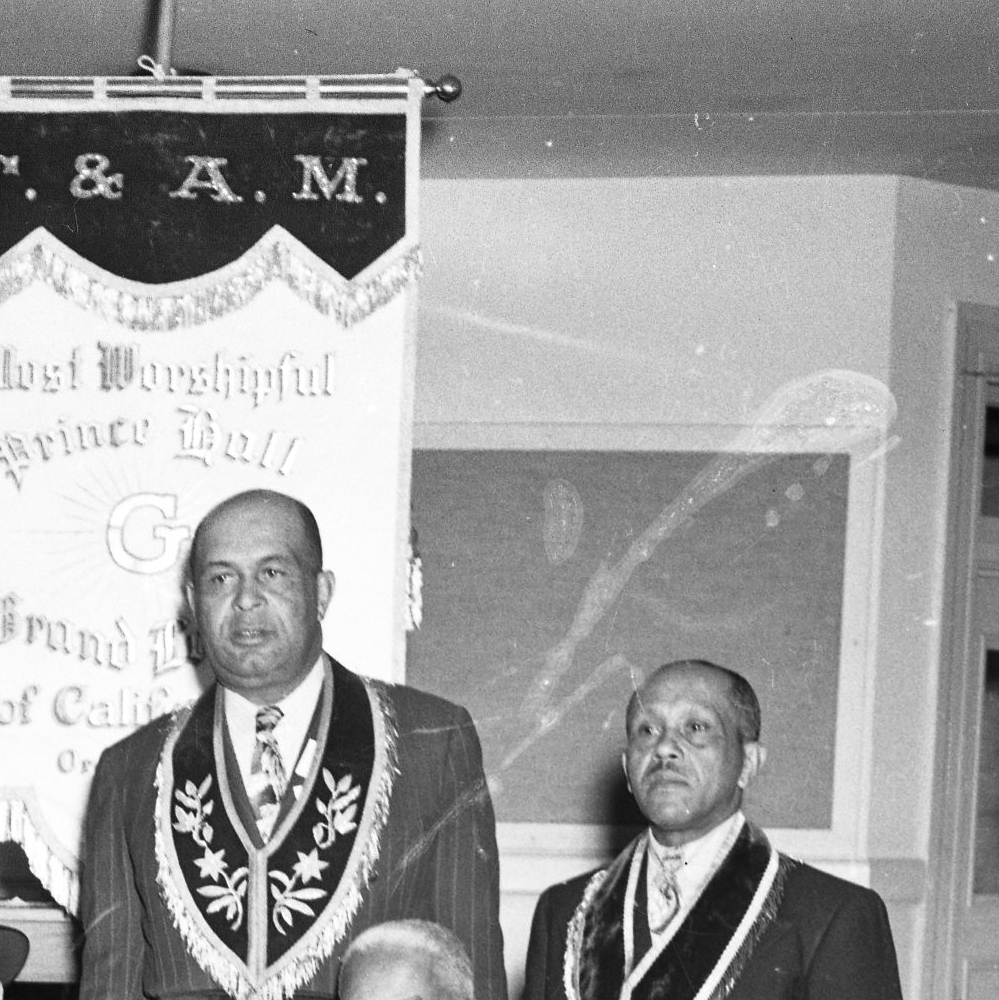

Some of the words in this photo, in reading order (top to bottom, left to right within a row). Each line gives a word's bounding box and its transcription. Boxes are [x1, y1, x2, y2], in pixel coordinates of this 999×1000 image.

[68, 152, 125, 202] &
[168, 154, 268, 205] A.
[291, 154, 388, 205] M.
[96, 340, 338, 408] Worshipful
[174, 404, 306, 477] Hall
[106, 490, 192, 576] G
